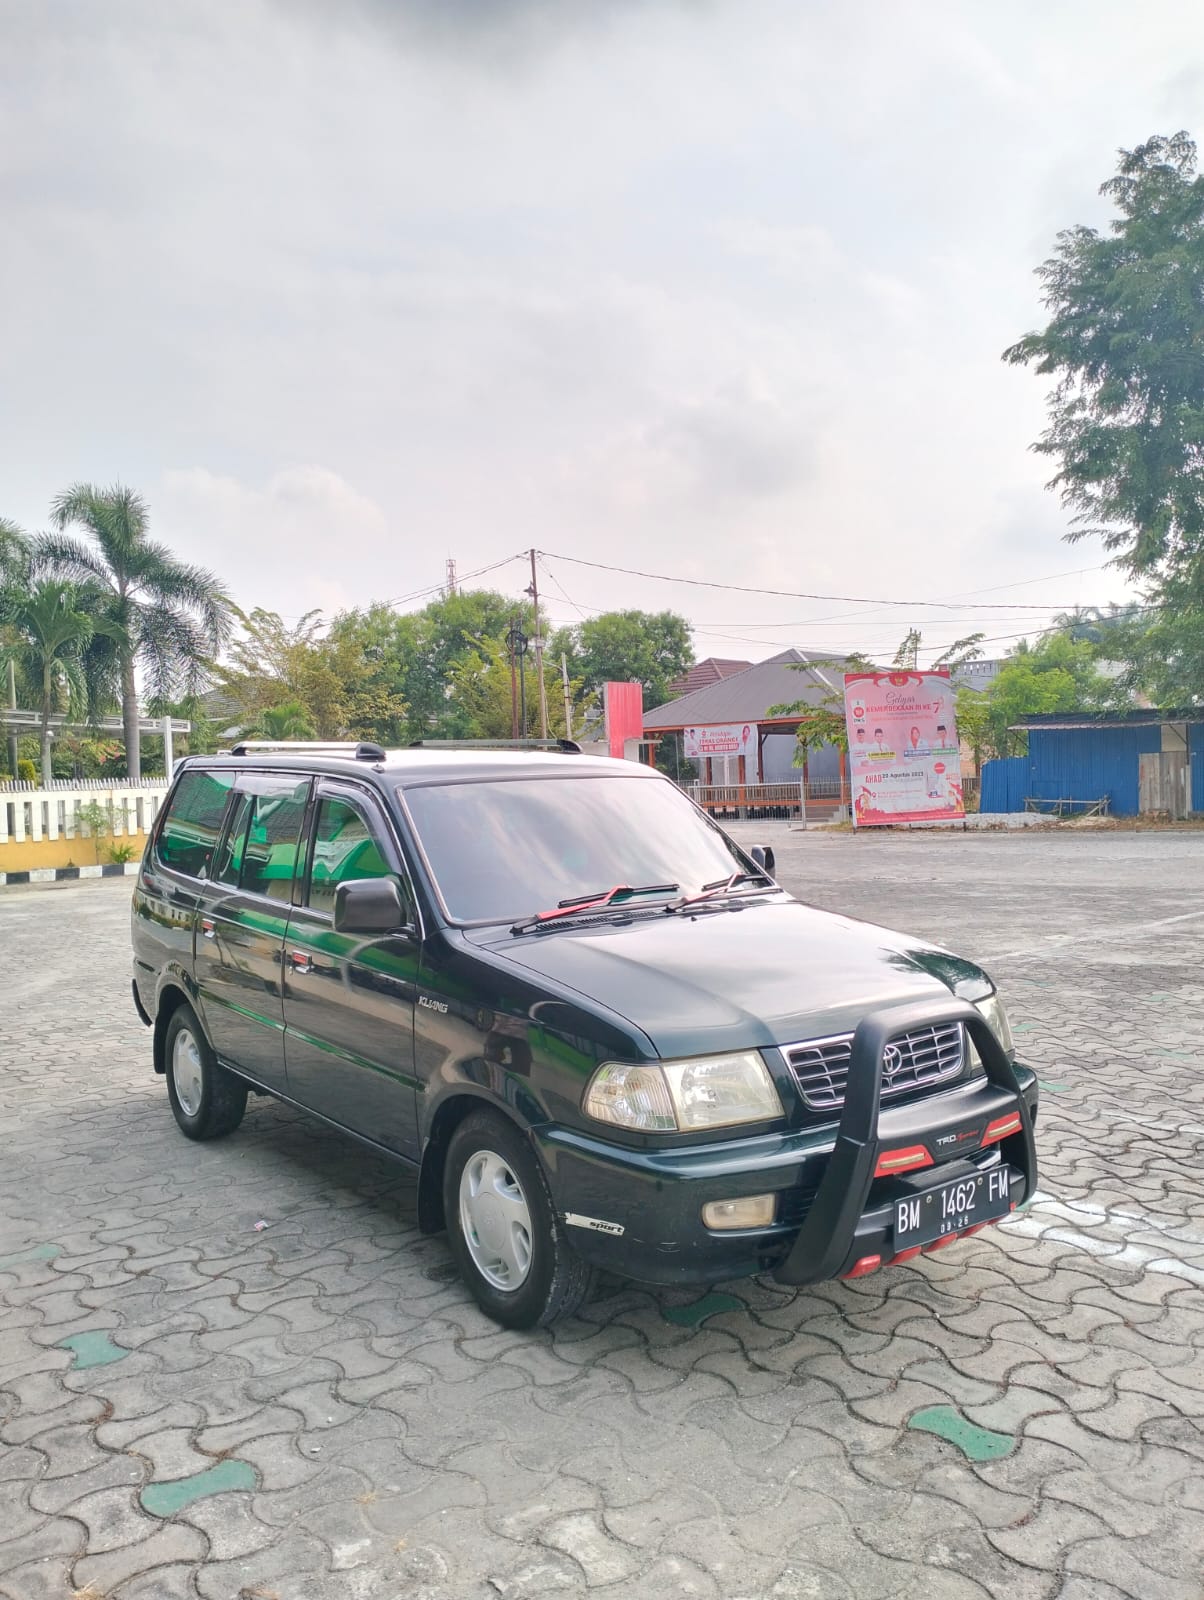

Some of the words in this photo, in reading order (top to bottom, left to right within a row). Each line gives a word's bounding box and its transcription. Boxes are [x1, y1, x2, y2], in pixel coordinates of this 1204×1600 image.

[936, 1134, 957, 1146] TRD
[898, 1199, 921, 1233] BM
[941, 1180, 976, 1219] 1462
[988, 1169, 1009, 1202] FM
